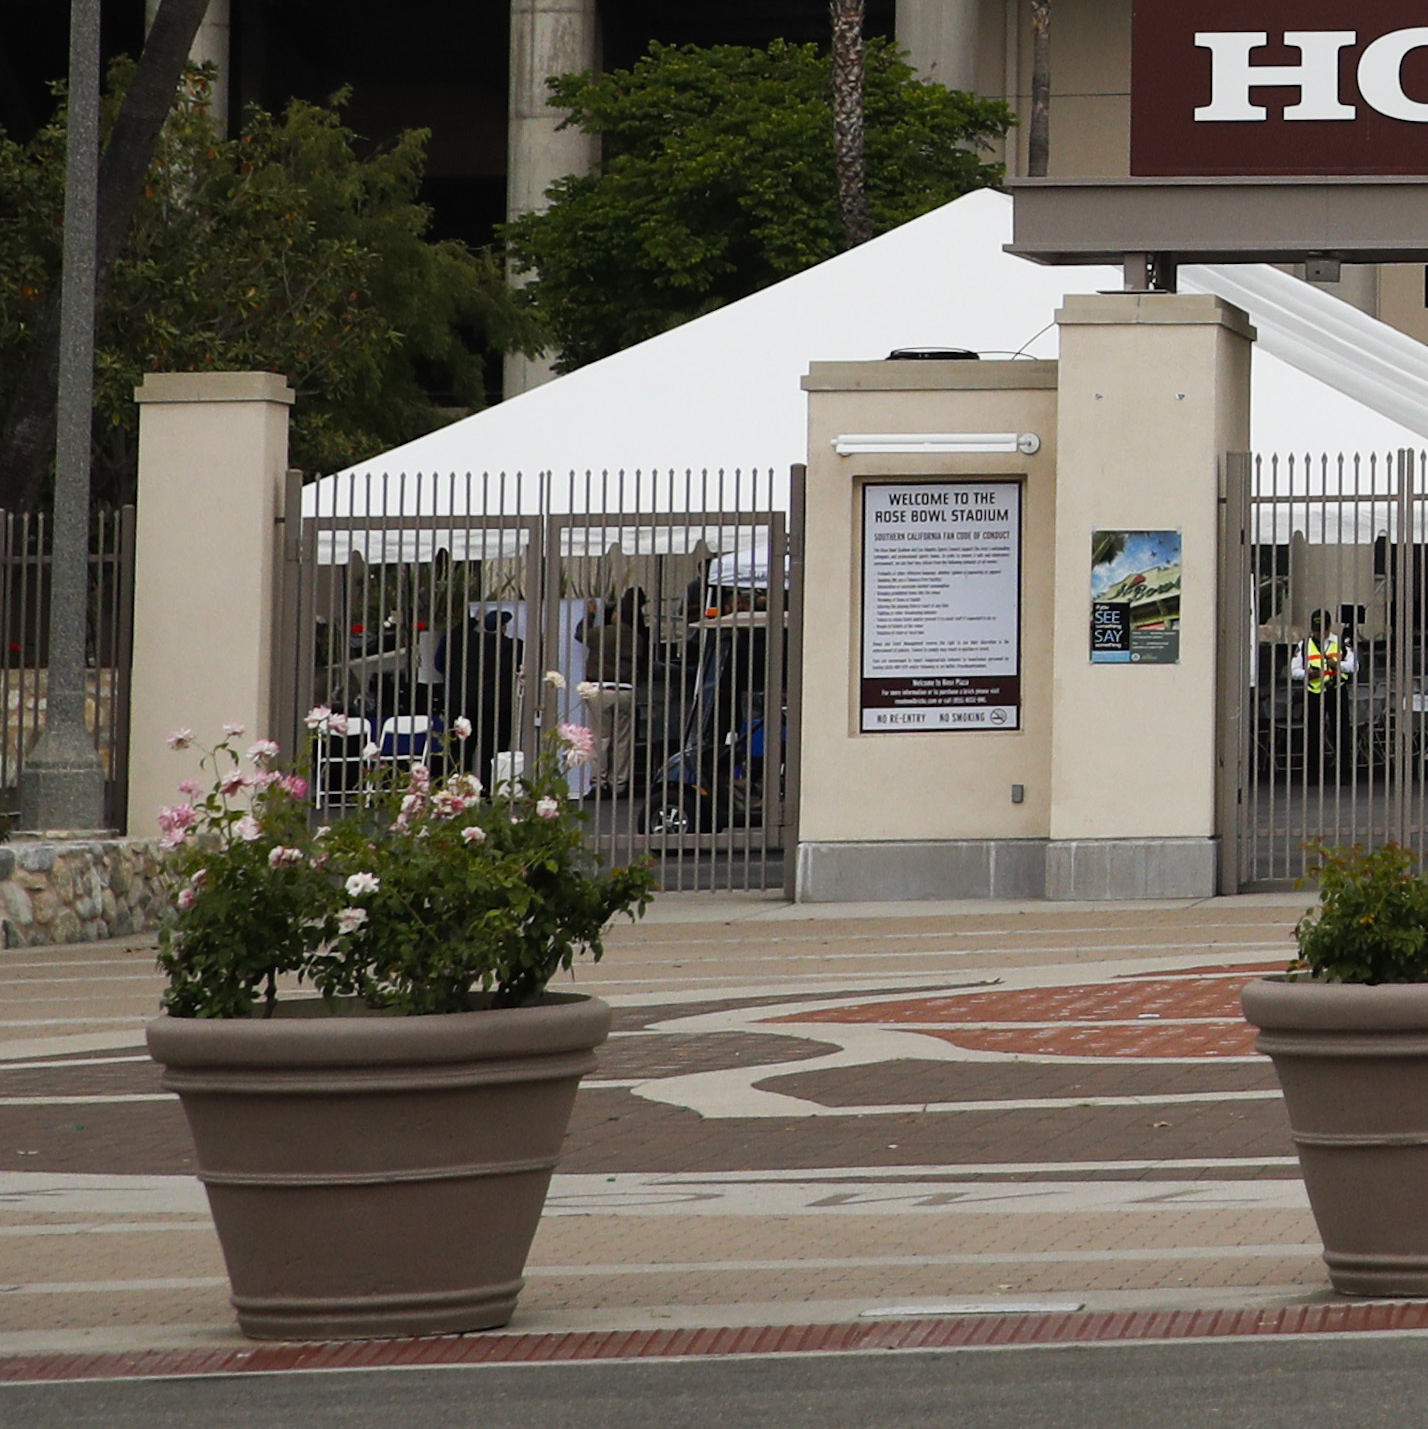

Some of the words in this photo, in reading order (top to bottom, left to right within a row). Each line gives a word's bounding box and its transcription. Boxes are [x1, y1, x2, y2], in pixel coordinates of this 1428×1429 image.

[889, 492, 949, 506] WELCOME
[953, 492, 969, 505] TO
[973, 492, 996, 504] THE
[875, 510, 907, 523] ROSE
[911, 510, 947, 523] BOWL
[951, 509, 1009, 522] STADIUM
[874, 532, 905, 541] SOUTHERN
[906, 532, 942, 541] CALIFORNIA
[943, 532, 955, 540] FAN
[956, 531, 971, 540] CODE
[973, 531, 980, 540] OF
[982, 531, 1010, 540] CONDUCT
[1095, 610, 1120, 624] SEE
[1095, 629, 1124, 643] SAY
[877, 714, 888, 724] NO
[890, 713, 926, 724] RE-ENTRY
[939, 713, 950, 723] NO
[951, 712, 986, 722] SMOKING
